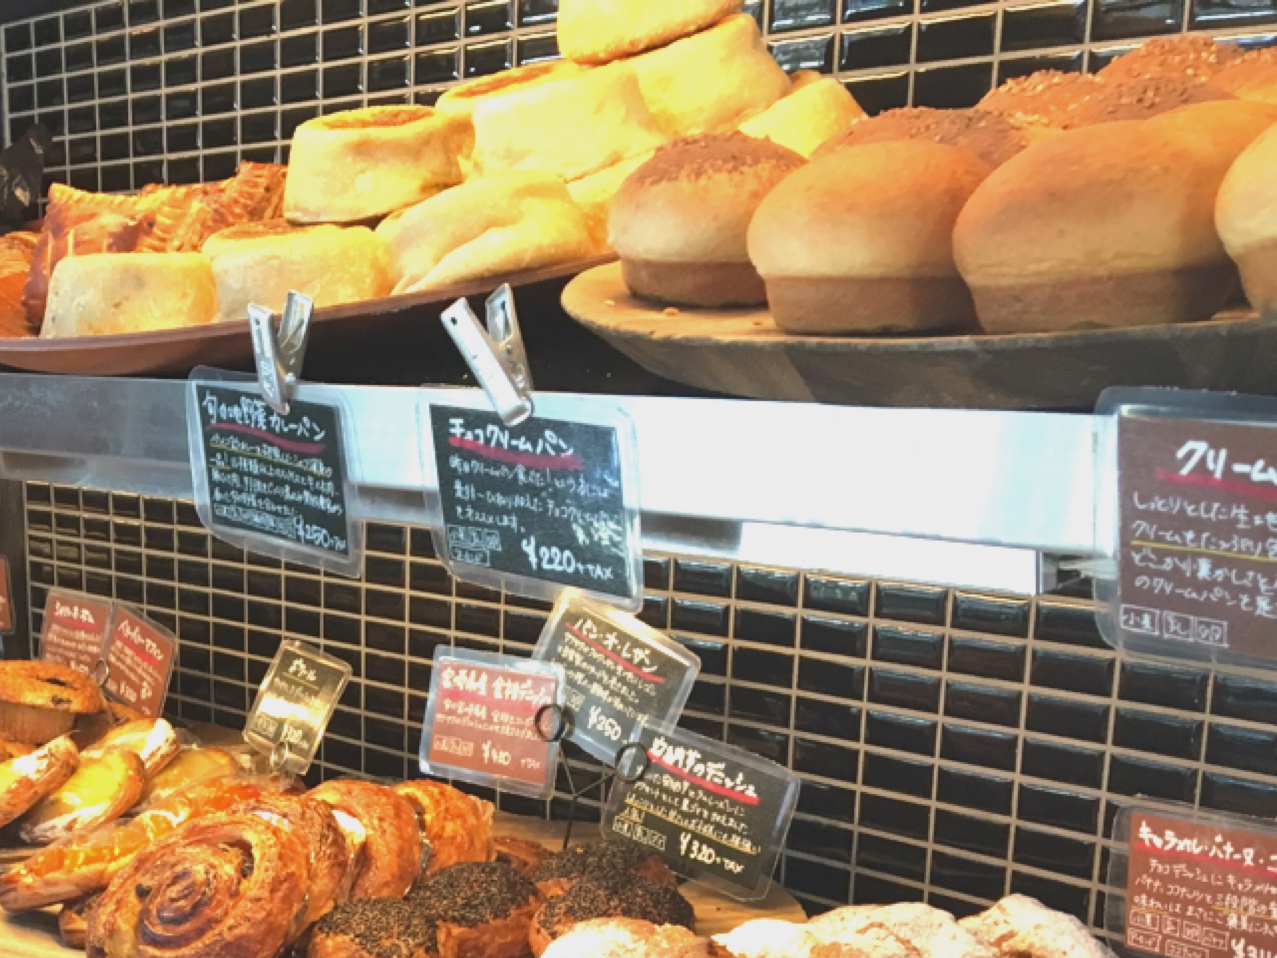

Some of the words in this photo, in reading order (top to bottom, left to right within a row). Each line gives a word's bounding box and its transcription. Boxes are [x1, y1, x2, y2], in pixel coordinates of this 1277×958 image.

[449, 418, 574, 457] チョコクリームパン
[1176, 440, 1277, 485] クリーム
[521, 535, 574, 573] ¥220
